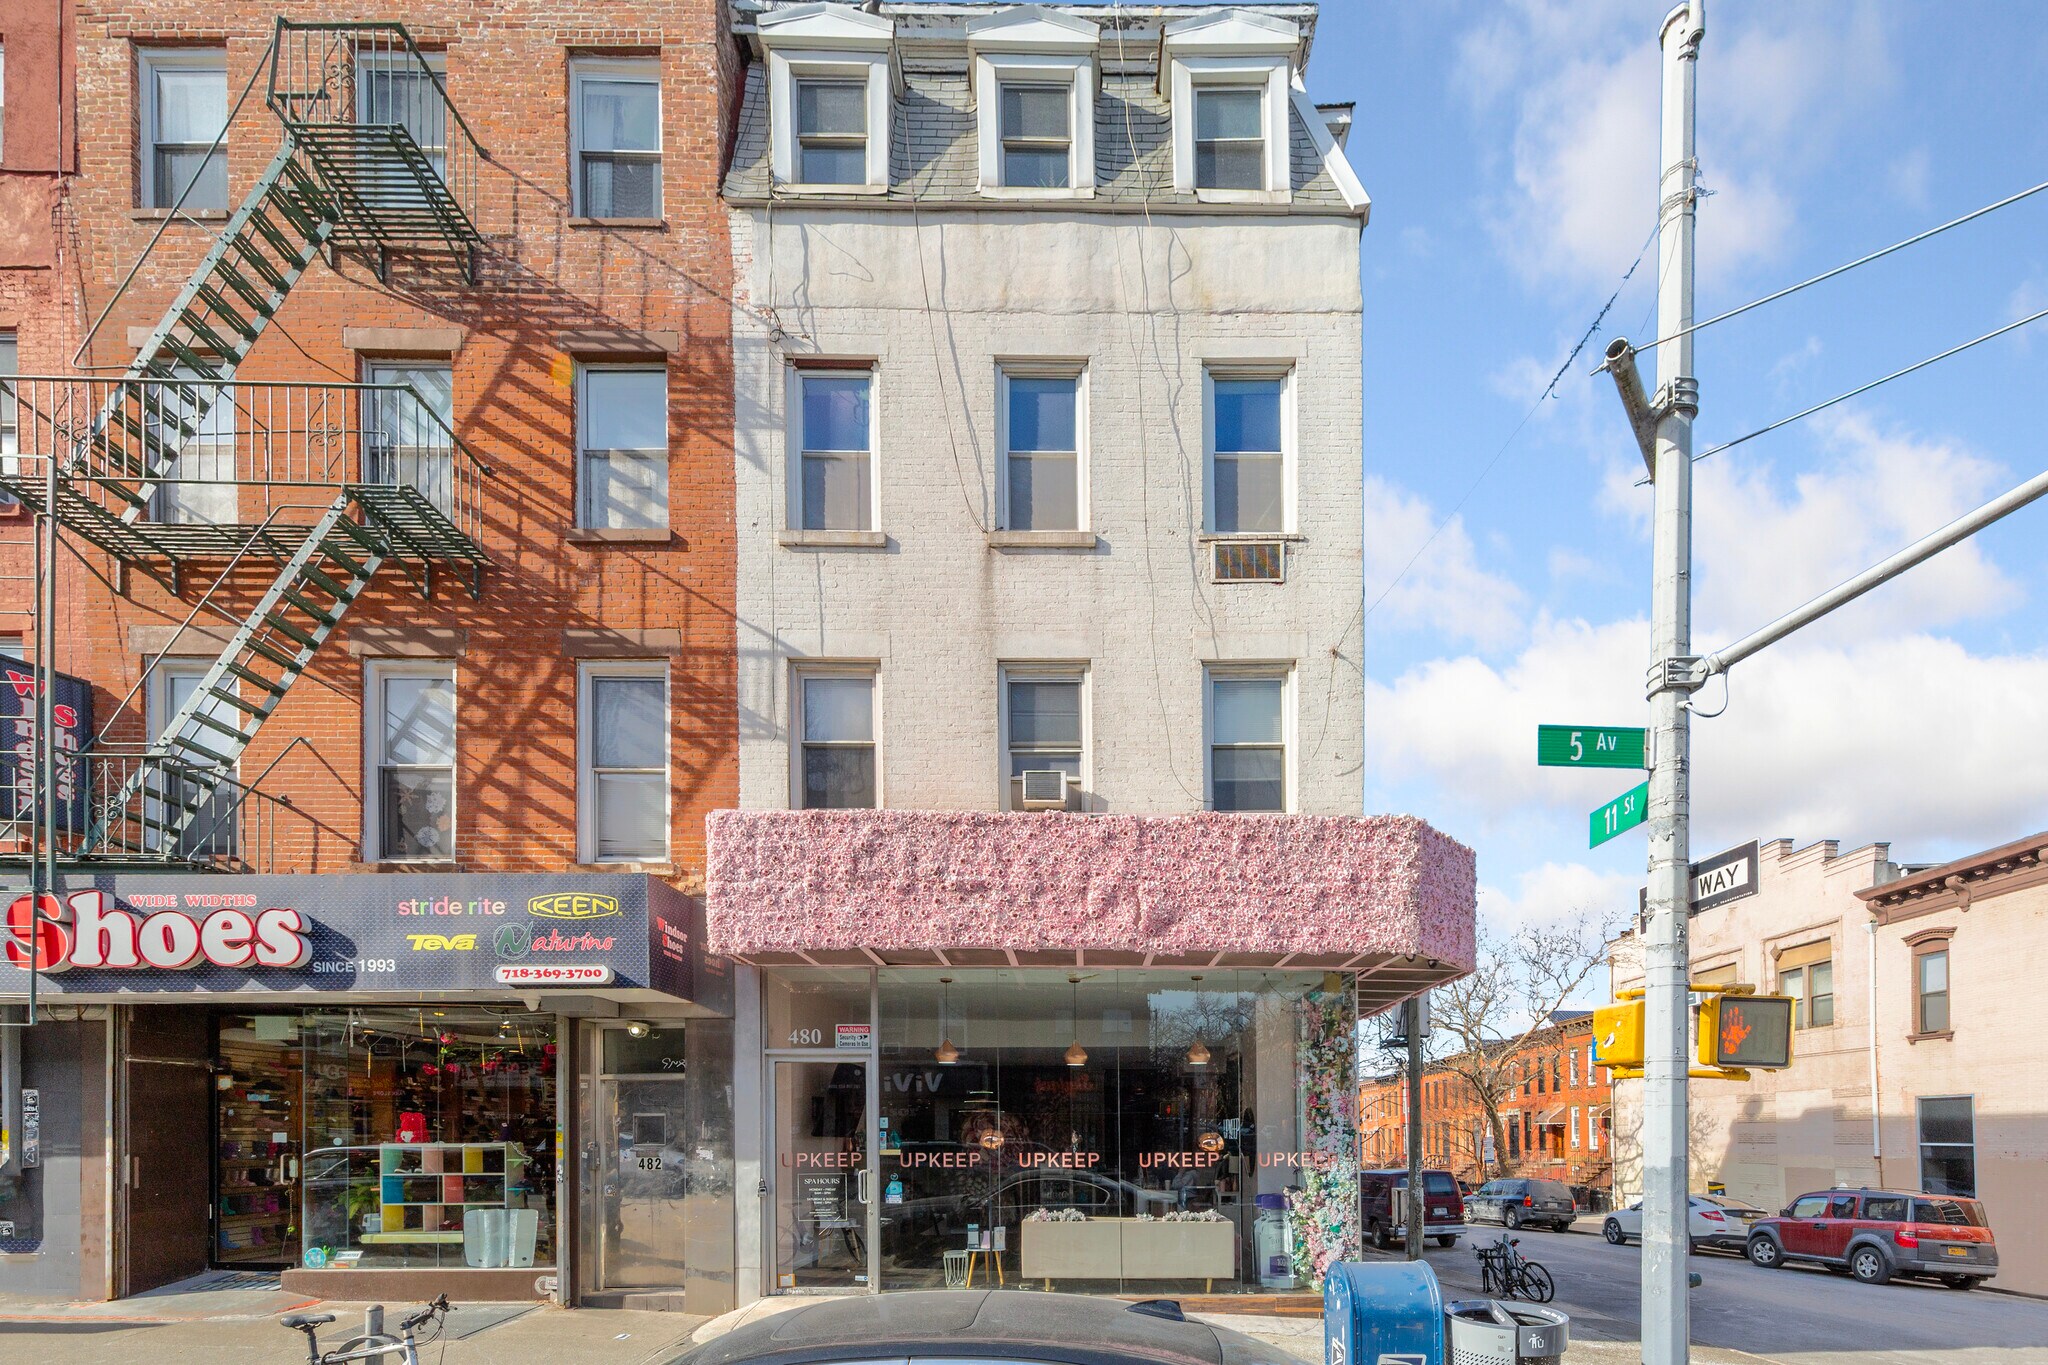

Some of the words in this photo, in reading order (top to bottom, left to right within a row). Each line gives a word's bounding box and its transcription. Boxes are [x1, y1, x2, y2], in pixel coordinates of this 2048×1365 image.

[1570, 731, 1583, 762] 5
[1596, 732, 1617, 751] Av
[1604, 804, 1617, 835] 11
[1624, 794, 1635, 815] St
[1699, 864, 1739, 897] WAY
[128, 894, 178, 907] WIDE
[184, 894, 257, 907] WIDTHS
[398, 896, 463, 916] stride
[468, 896, 506, 916] rite
[532, 896, 614, 916] KEEN
[5, 889, 308, 972] Shoes
[656, 916, 688, 943] Windsor
[495, 921, 617, 960] Naturino
[662, 933, 684, 954] Shoes
[313, 962, 354, 973] SINCE
[358, 959, 396, 973] 1993
[502, 968, 603, 979] 718-369-3700
[787, 1028, 822, 1045] 480
[638, 1158, 662, 1170] 482
[781, 1152, 862, 1168] UPKEEP
[900, 1152, 981, 1168] UPKEEP
[1018, 1152, 1100, 1168] UPKEEP
[1138, 1152, 1220, 1168] UPKEEP
[1258, 1152, 1338, 1167] UPKEEP
[817, 1177, 840, 1185] HOURS
